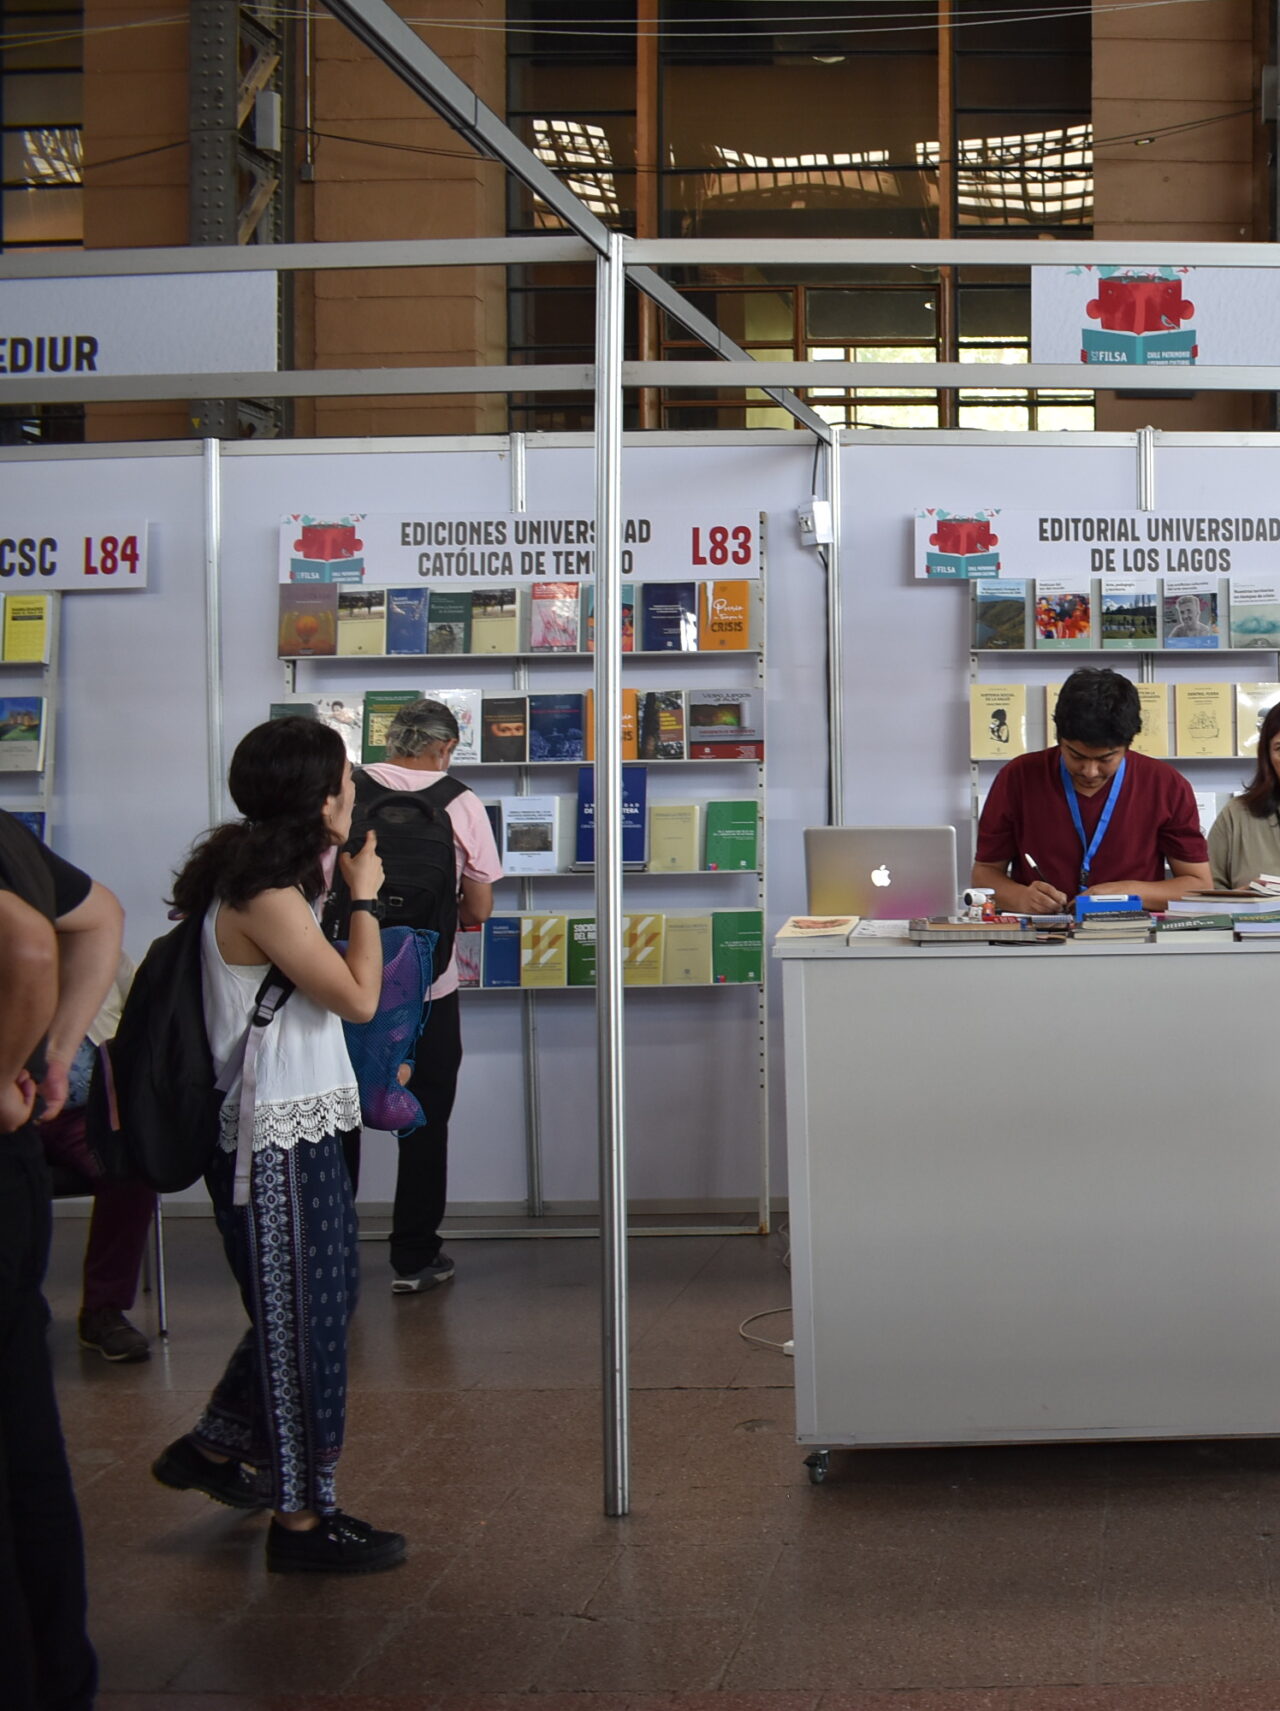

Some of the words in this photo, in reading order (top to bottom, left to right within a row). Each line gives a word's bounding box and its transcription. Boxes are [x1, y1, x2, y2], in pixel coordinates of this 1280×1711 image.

[1099, 351, 1128, 362] FILSA
[401, 521, 507, 547] EDICIONES
[1038, 517, 1140, 542] EDITORIAL
[1147, 517, 1280, 542] UNIVERSIDAD
[84, 535, 140, 575] L84
[692, 525, 752, 566] L83
[418, 547, 514, 577] CATÓLICA
[521, 551, 546, 575] DE
[1091, 548, 1115, 572] DE
[1123, 548, 1160, 572] LOS
[1167, 548, 1231, 572] LAGOS
[711, 621, 744, 633] CRISIS
